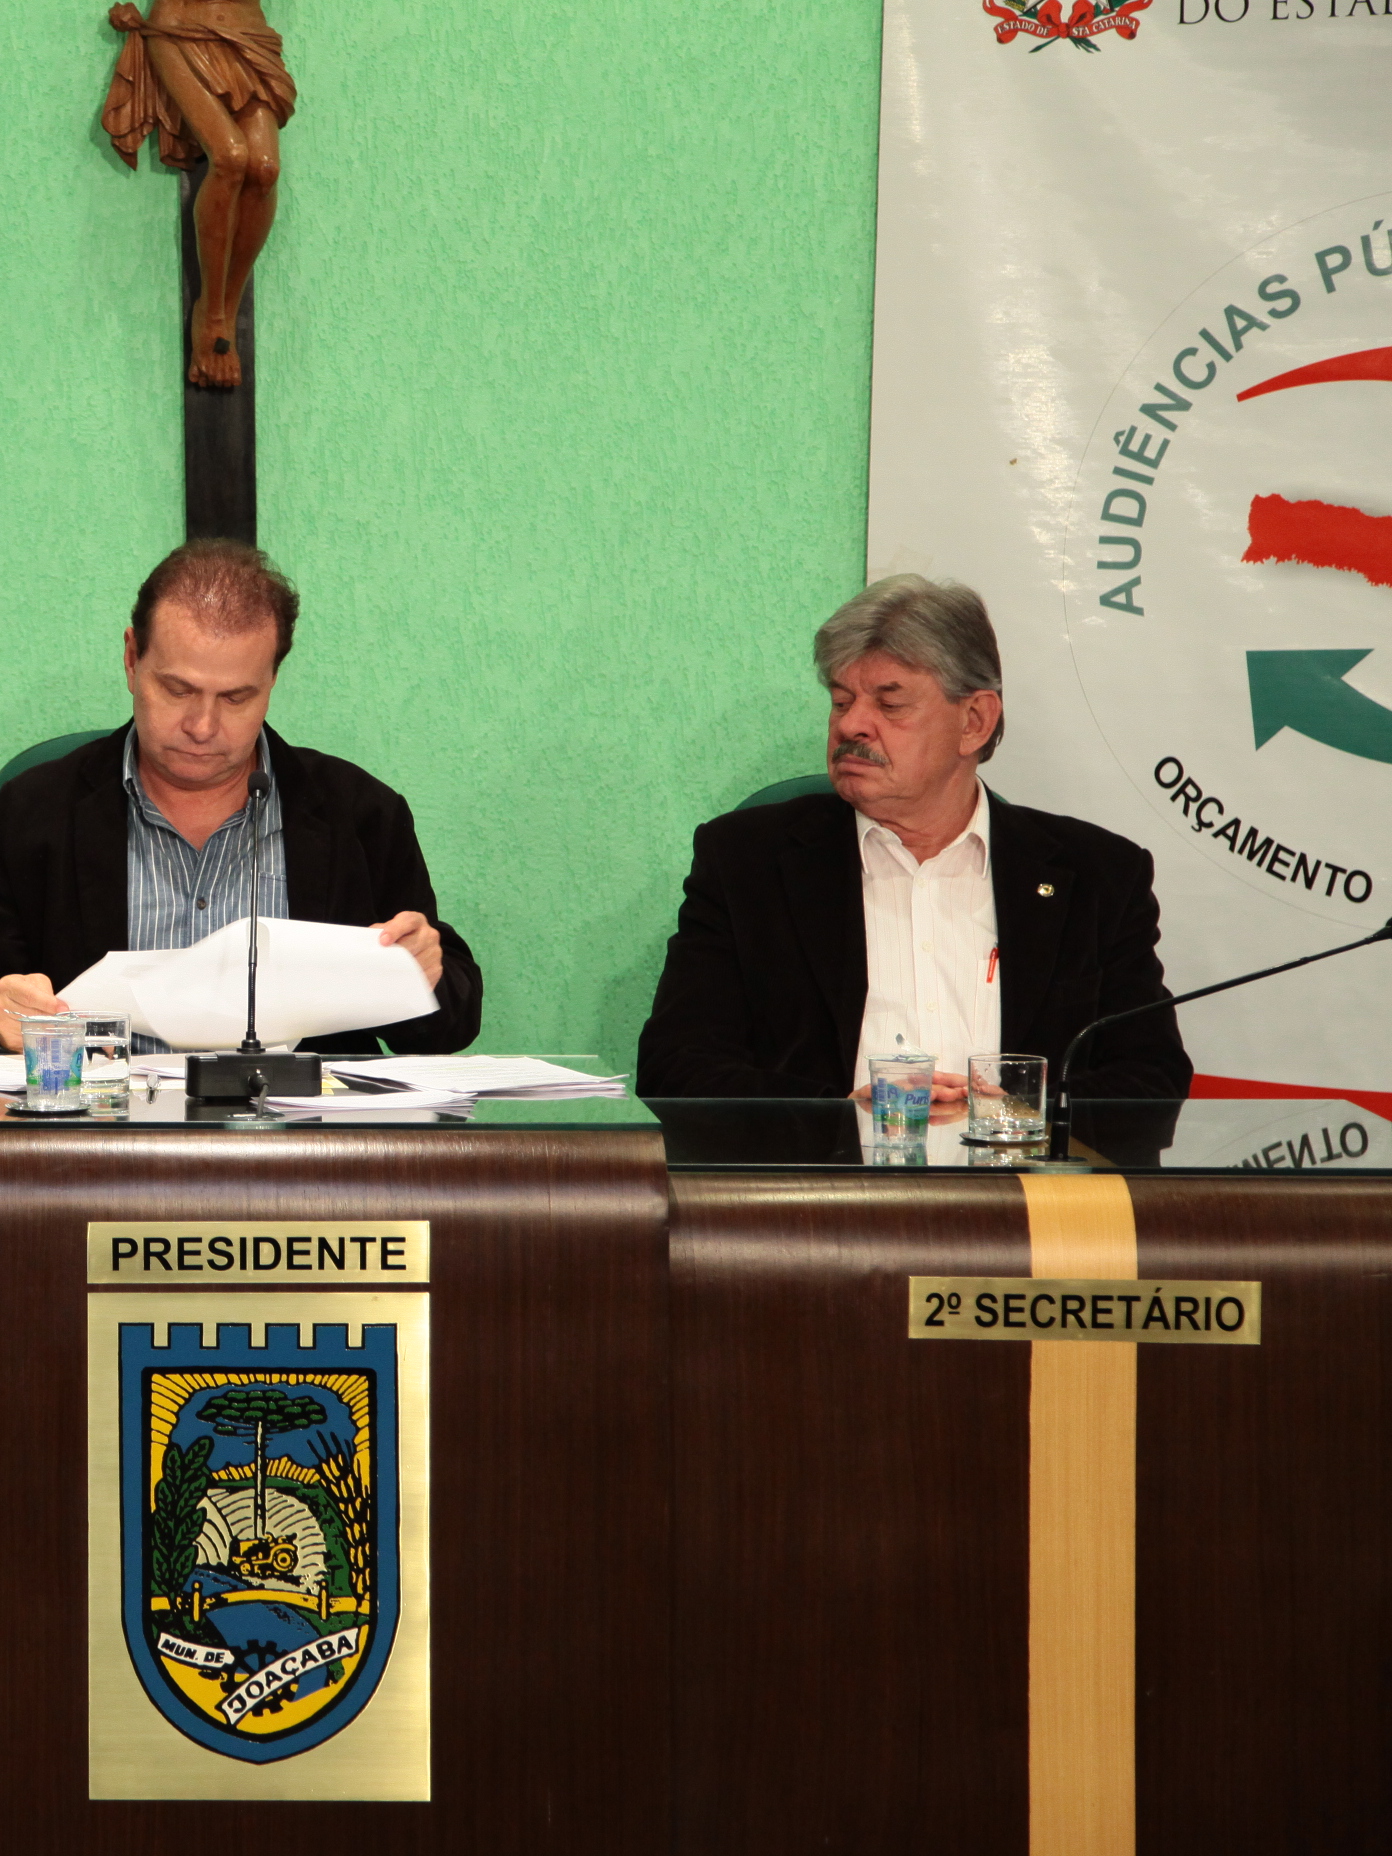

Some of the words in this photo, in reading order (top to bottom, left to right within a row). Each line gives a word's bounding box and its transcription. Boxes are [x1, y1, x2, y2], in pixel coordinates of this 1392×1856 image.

[998, 21, 1035, 34] ESTADO
[1036, 26, 1049, 36] DE
[1092, 17, 1137, 32] CATARINA
[1096, 273, 1301, 617] AUDIÊNCIAS
[1314, 219, 1392, 294] PÚ
[1153, 756, 1373, 904] ORÇAMENTO
[111, 1236, 407, 1271] PRESIDENTE
[924, 1292, 962, 1327] 2º
[974, 1287, 1246, 1331] SECRETÁRIO
[160, 1638, 199, 1661] MUN.
[203, 1651, 226, 1664] DE
[226, 1634, 354, 1714] JOAÇABA
